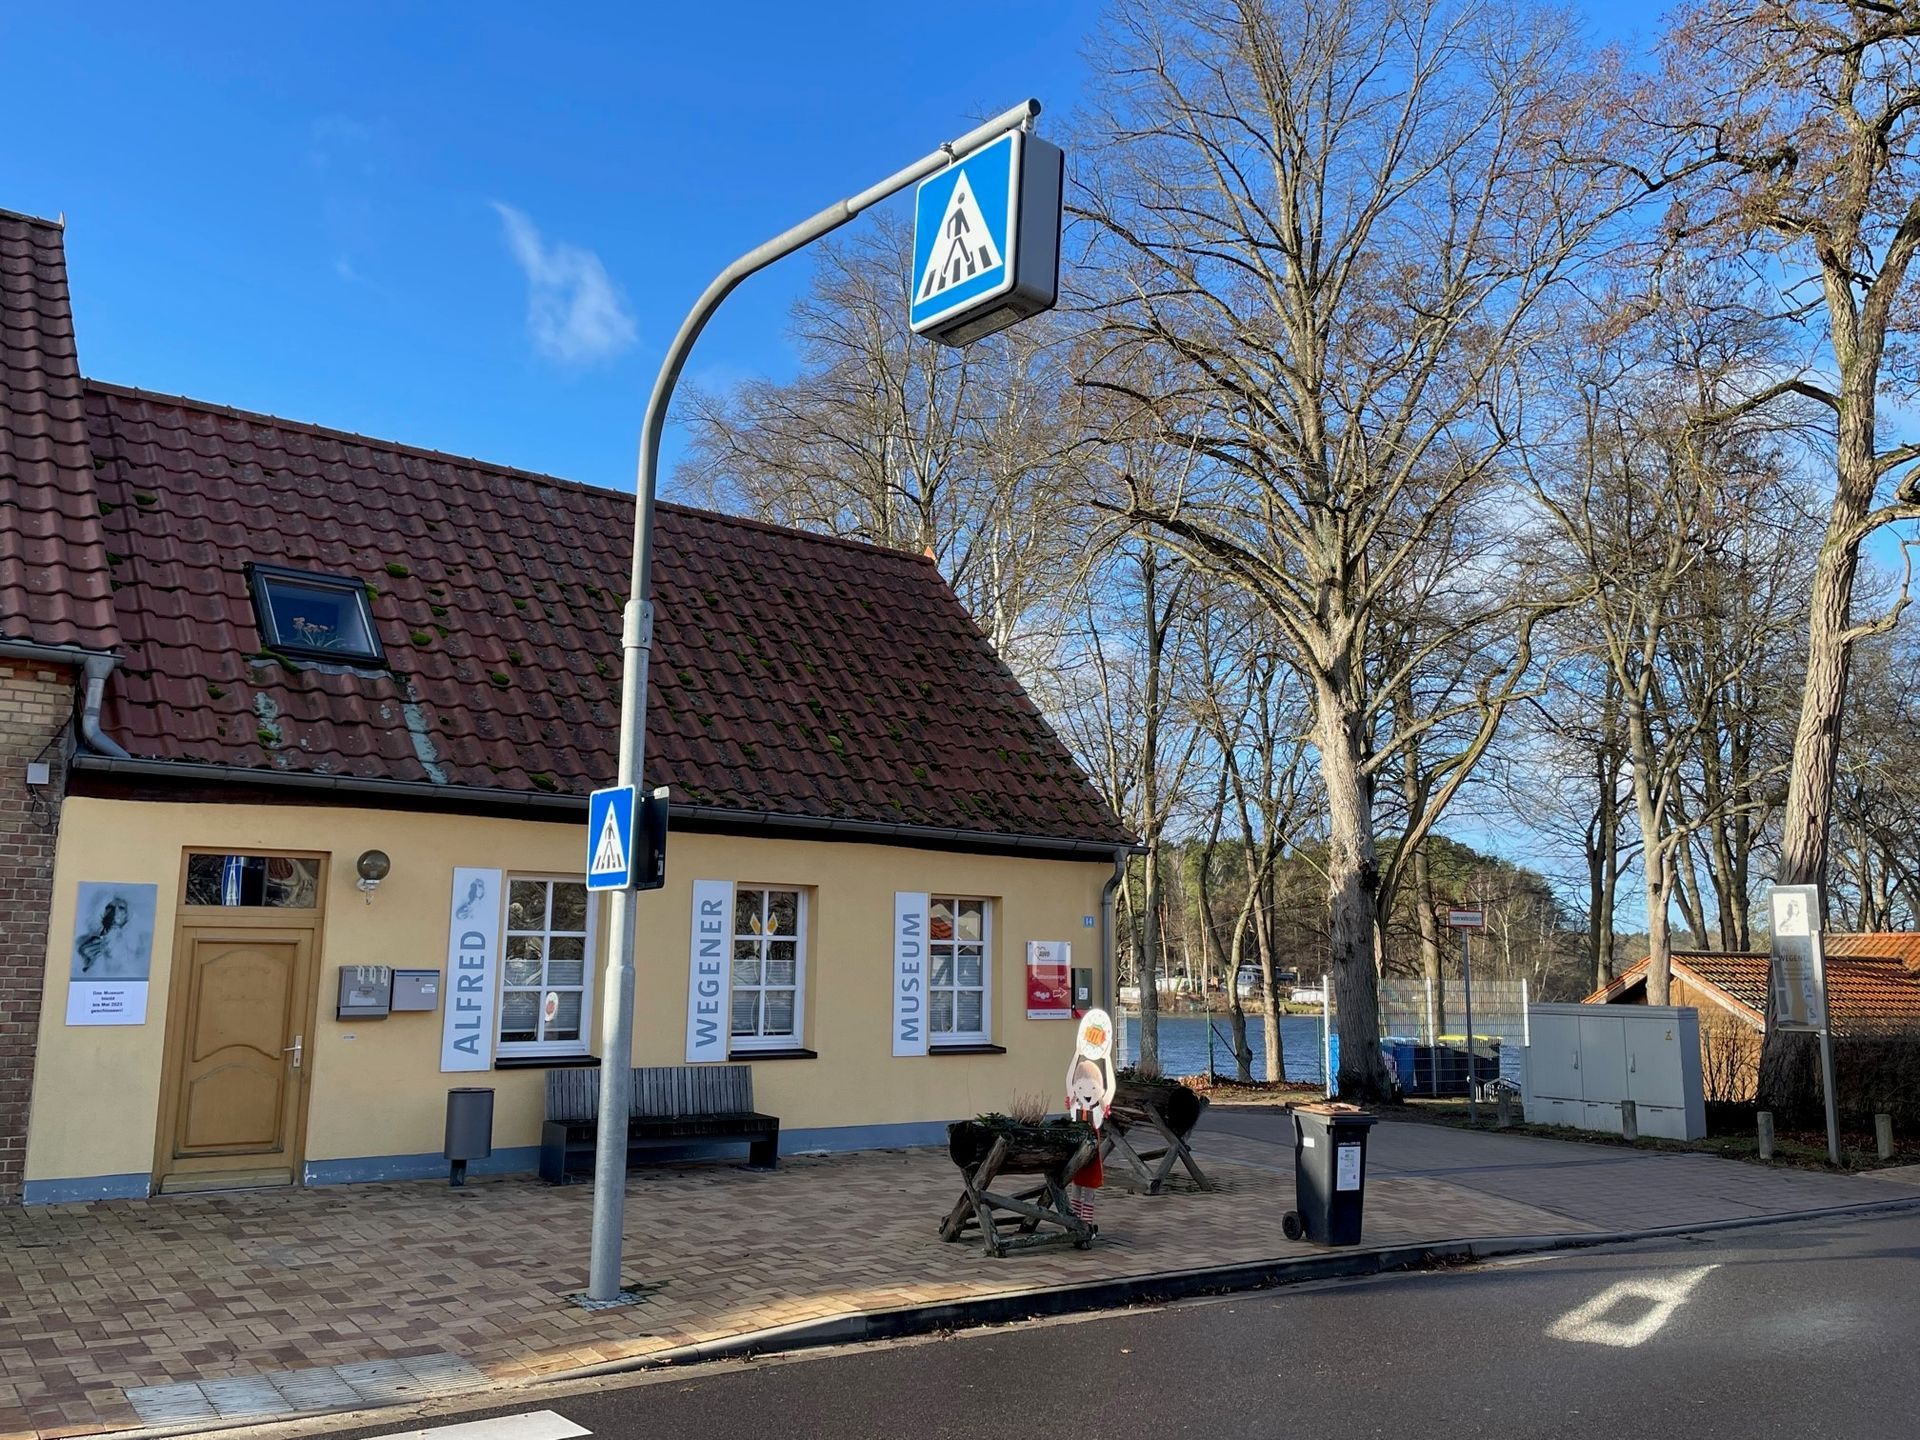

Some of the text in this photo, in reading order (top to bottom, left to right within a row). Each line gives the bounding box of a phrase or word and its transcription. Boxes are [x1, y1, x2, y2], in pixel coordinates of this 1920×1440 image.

[453, 930, 486, 1056] ALFRED
[695, 899, 723, 1048] WEGENER
[900, 913, 921, 1042] MUSEUM
